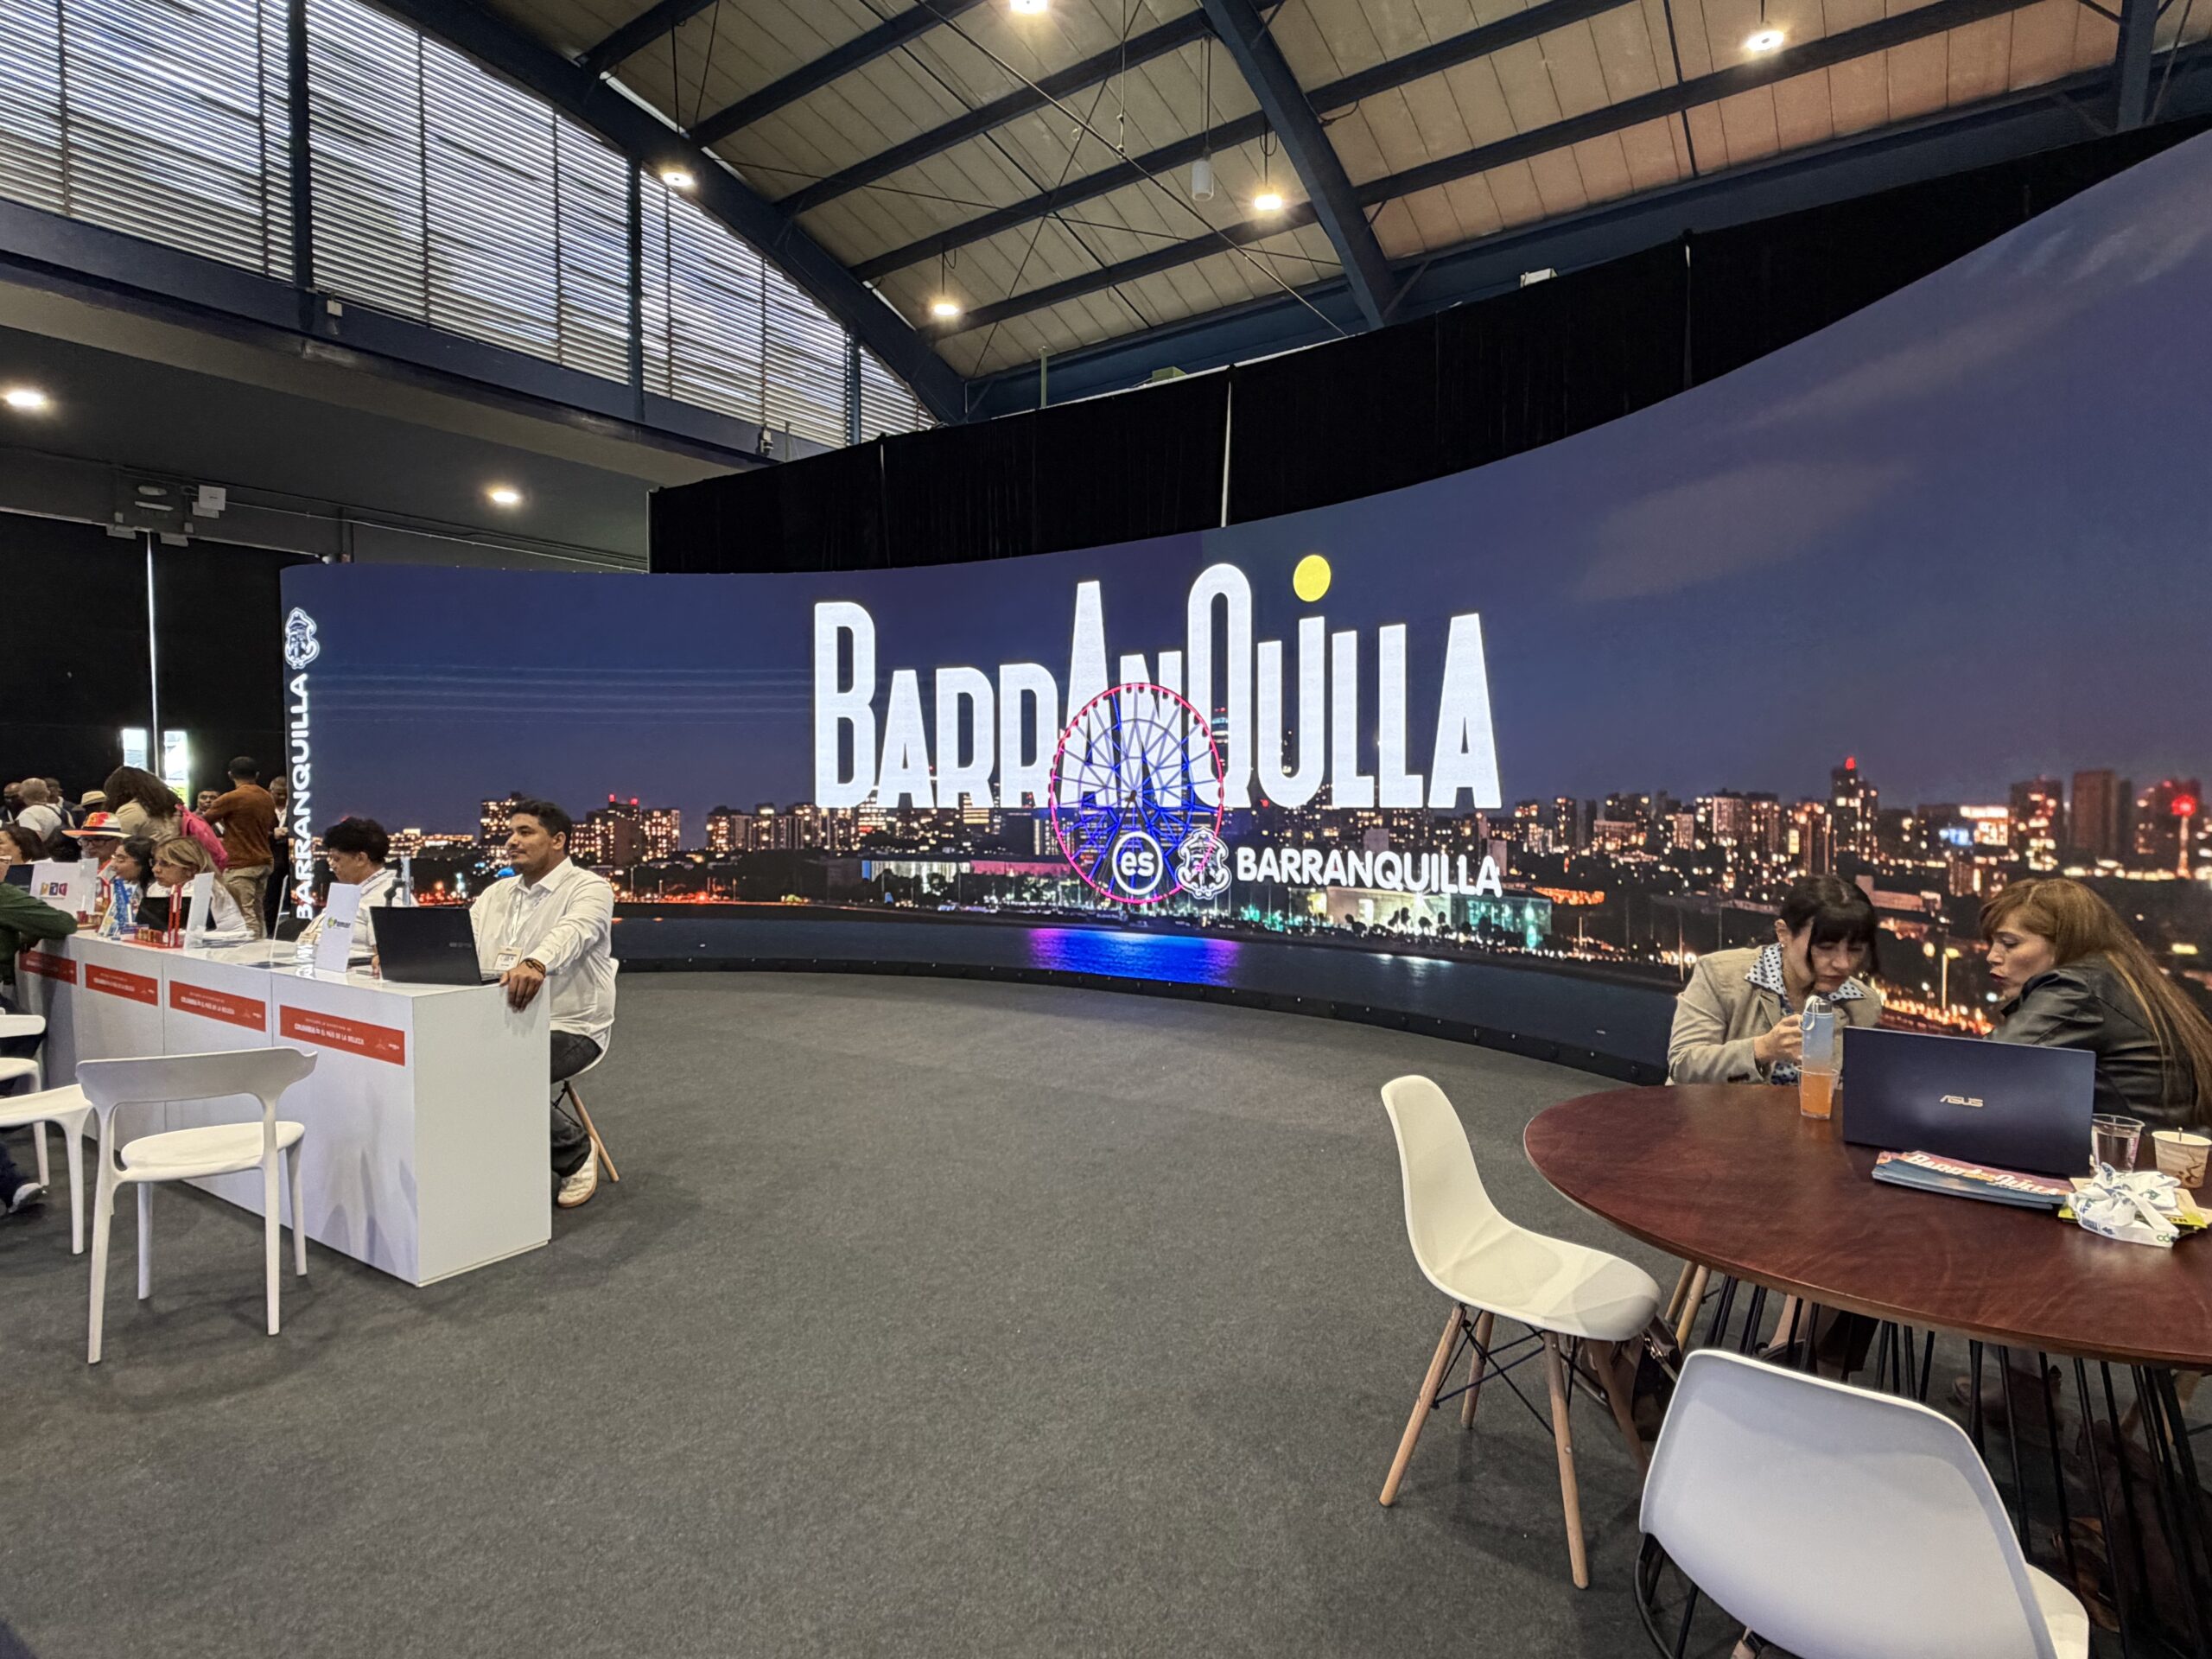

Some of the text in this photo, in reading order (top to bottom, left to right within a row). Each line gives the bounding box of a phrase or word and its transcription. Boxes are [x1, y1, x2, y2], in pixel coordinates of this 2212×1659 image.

[289, 673, 315, 919] BARRANQUILLA
[1121, 847, 1503, 898] es BARRANQUILLA
[1940, 1095, 1984, 1108] ASUS
